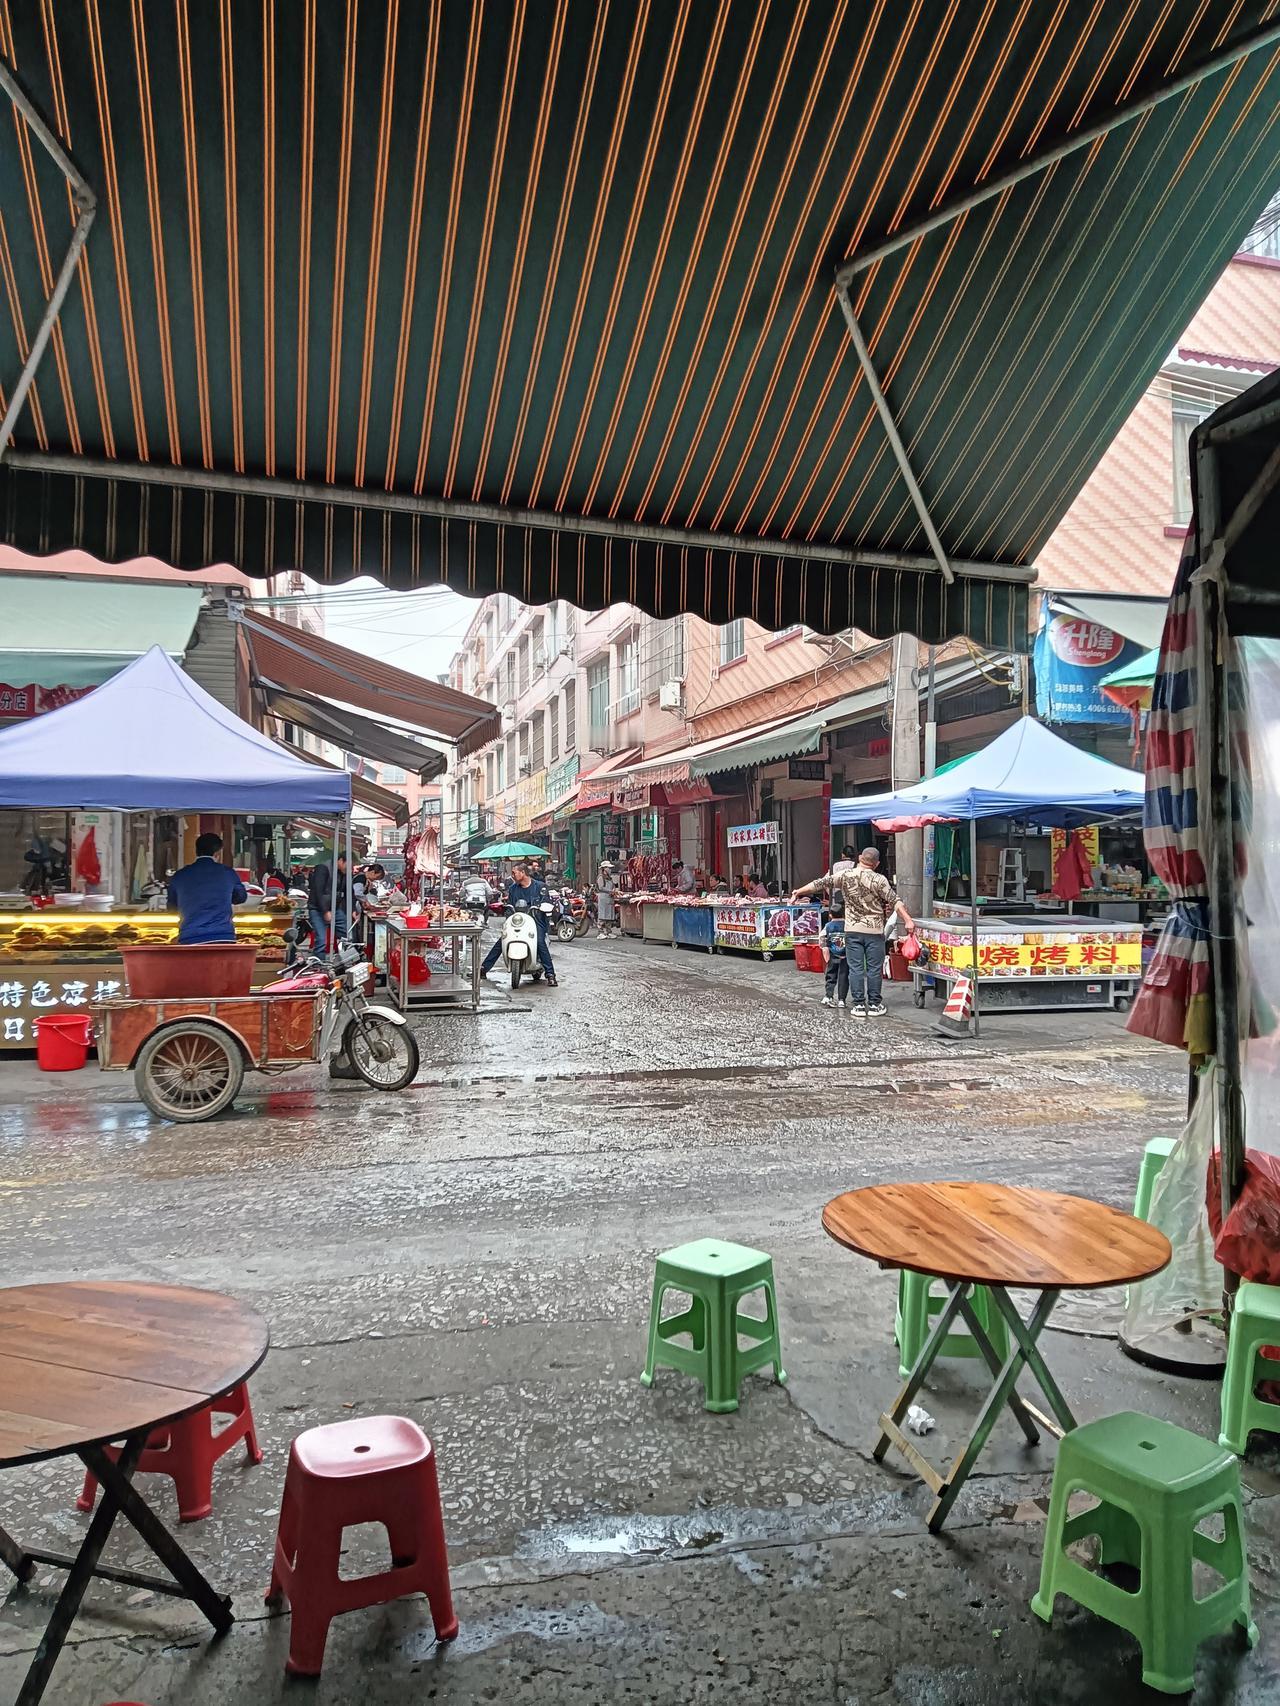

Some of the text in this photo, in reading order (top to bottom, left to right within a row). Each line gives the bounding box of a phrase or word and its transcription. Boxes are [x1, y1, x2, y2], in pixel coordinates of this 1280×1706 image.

[1063, 623, 1114, 650] 升隆
[0, 690, 27, 711] 分店
[979, 945, 1120, 966] 烧烤料
[0, 980, 131, 1008] 特色凉拌
